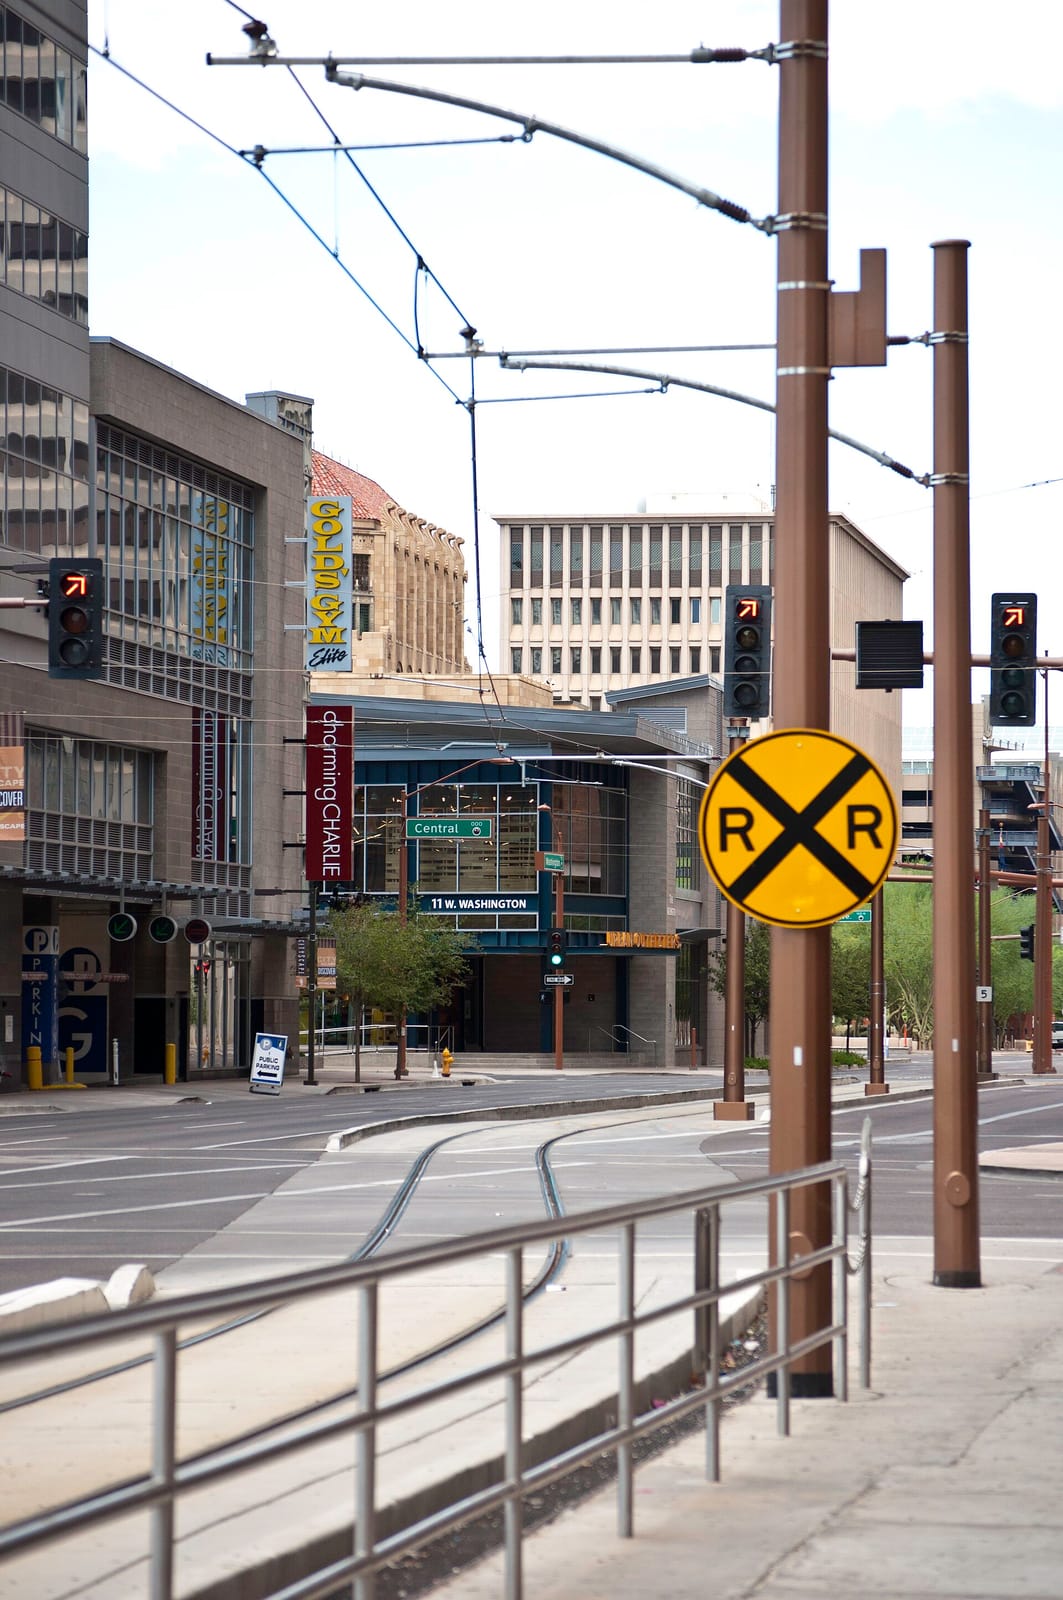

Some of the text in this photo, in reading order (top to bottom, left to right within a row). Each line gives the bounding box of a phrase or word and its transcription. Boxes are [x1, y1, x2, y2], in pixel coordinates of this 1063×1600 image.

[309, 500, 349, 645] GOLD'S GYM
[309, 648, 348, 668] Elite
[414, 823, 459, 834] Central
[718, 804, 883, 852] R R
[322, 803, 342, 876] CHARLIE
[431, 898, 527, 909] 11 W. WASHINGTON
[981, 989, 988, 998] 5
[259, 1056, 279, 1064] PUBLIC
[256, 1063, 280, 1071] PARKING
